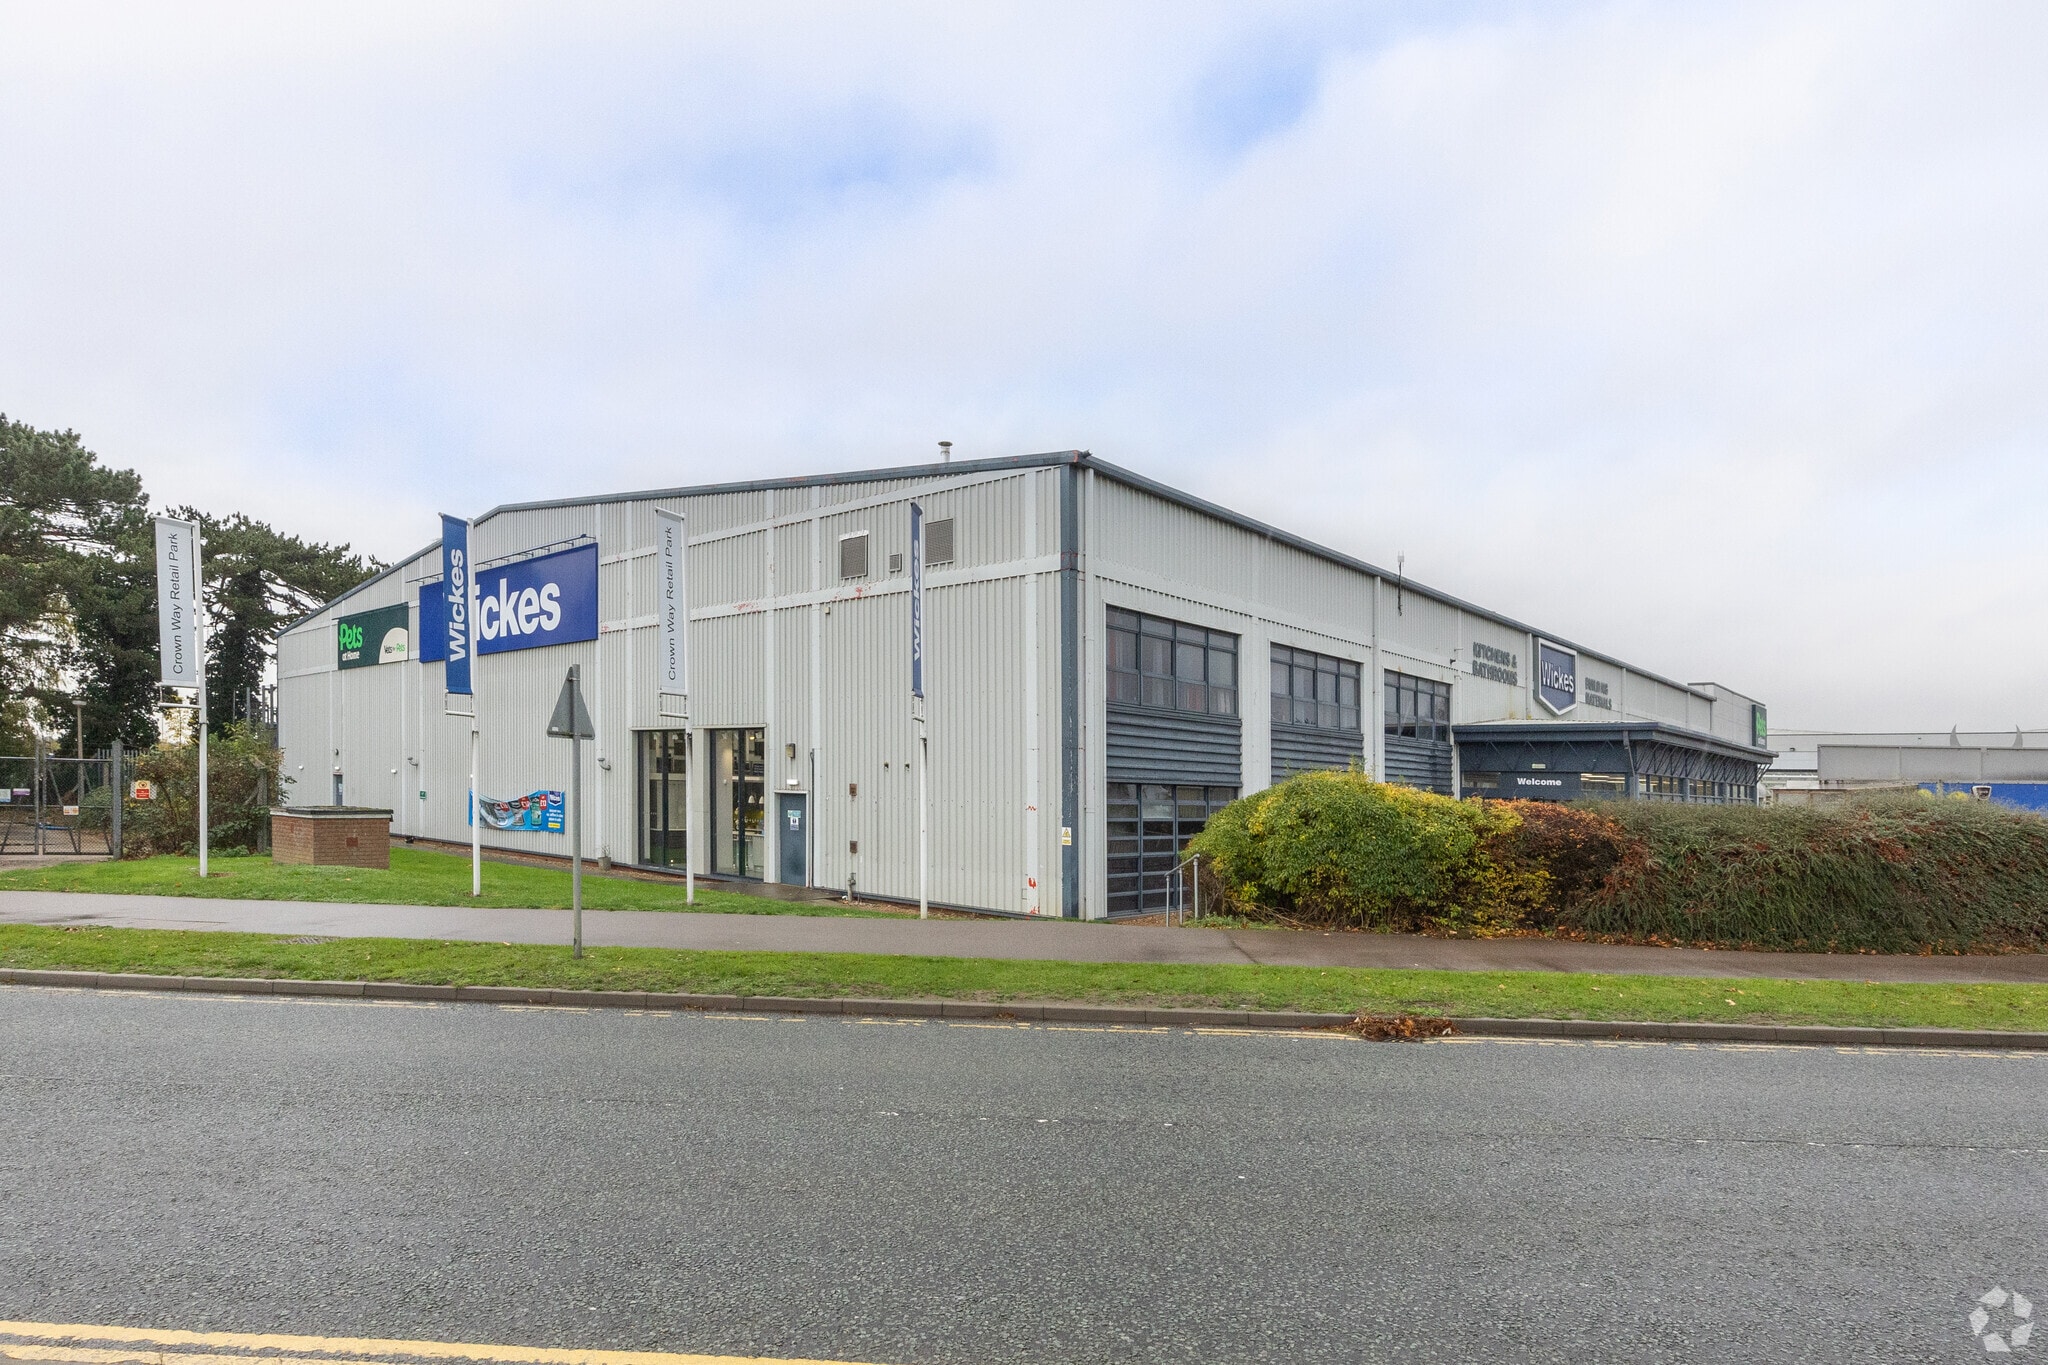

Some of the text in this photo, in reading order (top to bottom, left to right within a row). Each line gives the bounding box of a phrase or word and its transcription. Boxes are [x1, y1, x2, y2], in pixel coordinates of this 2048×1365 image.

[168, 532, 184, 675] Crown Way Retail Park
[448, 548, 466, 663] Wickes
[475, 577, 562, 642] ickes
[665, 526, 676, 681] Crown Way Retail Park
[339, 623, 363, 651] Pets
[1472, 641, 1518, 669] KITCHENS &
[1472, 659, 1518, 686] BATHROOMS
[1541, 660, 1575, 693] Wickes
[1517, 777, 1562, 786] Welcome
